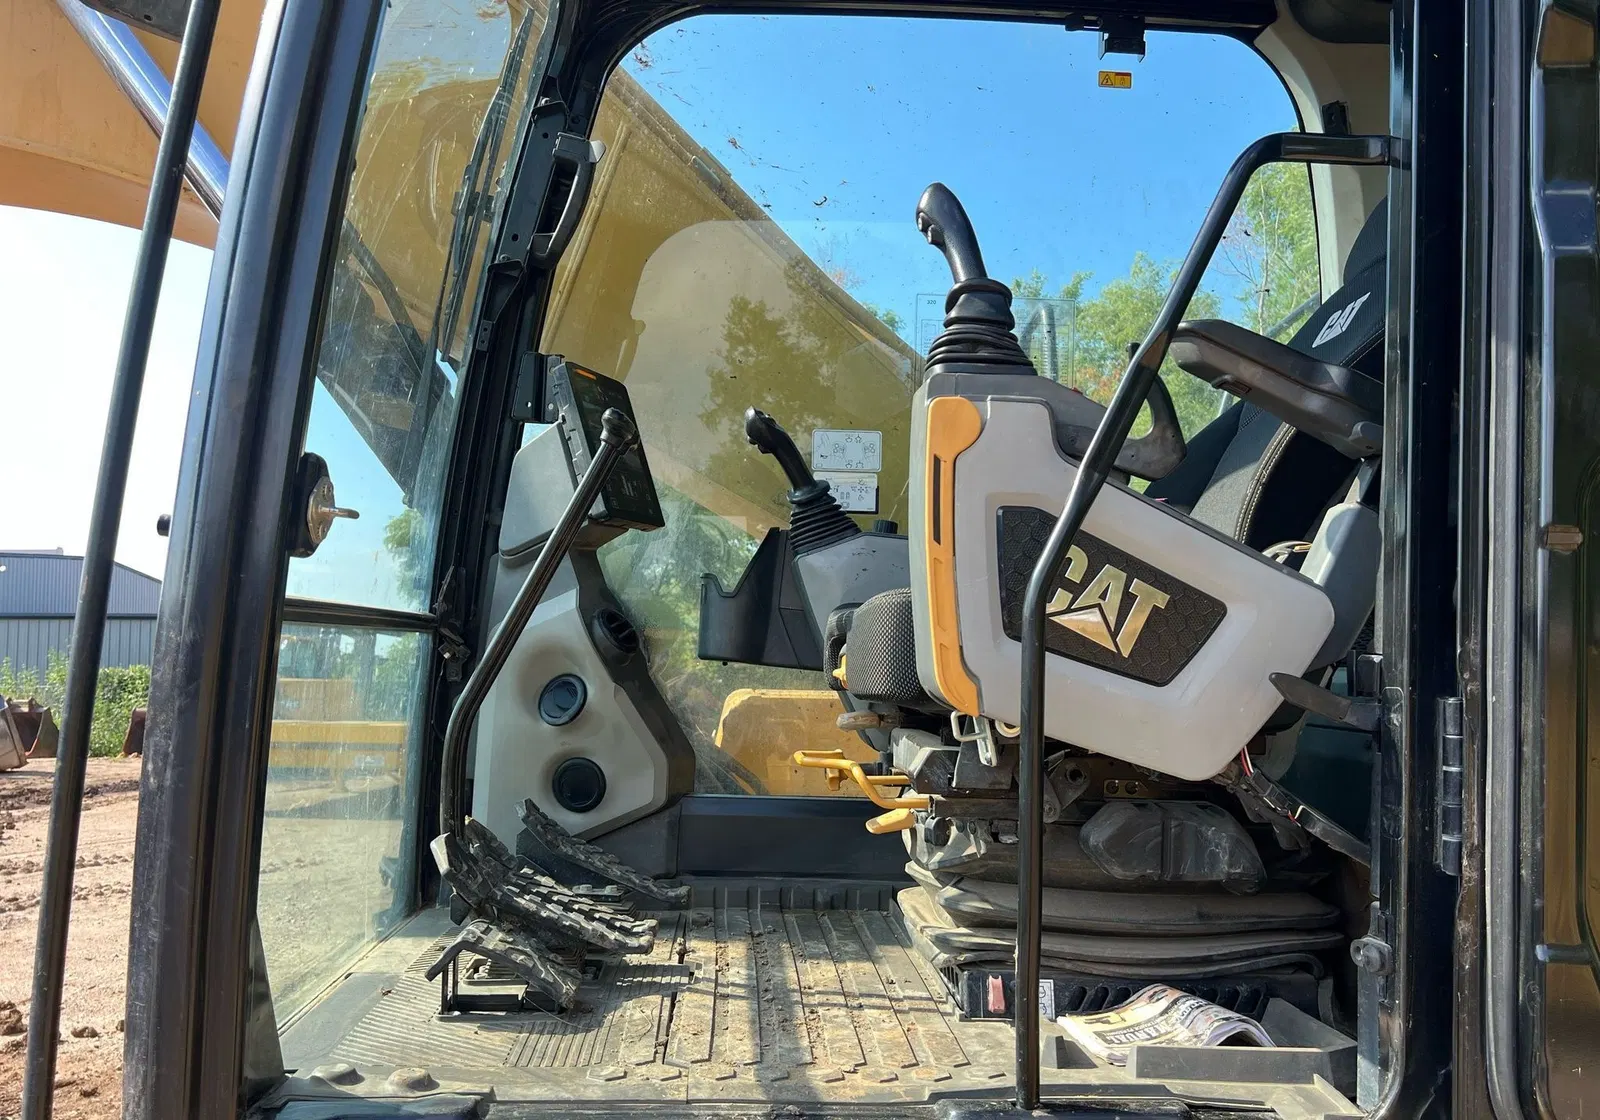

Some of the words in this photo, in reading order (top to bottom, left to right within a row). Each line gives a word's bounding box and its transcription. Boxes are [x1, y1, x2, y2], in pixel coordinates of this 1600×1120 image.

[1312, 291, 1371, 348] CAT
[1046, 544, 1170, 658] CAT
[1106, 1020, 1170, 1043] MANUAL
